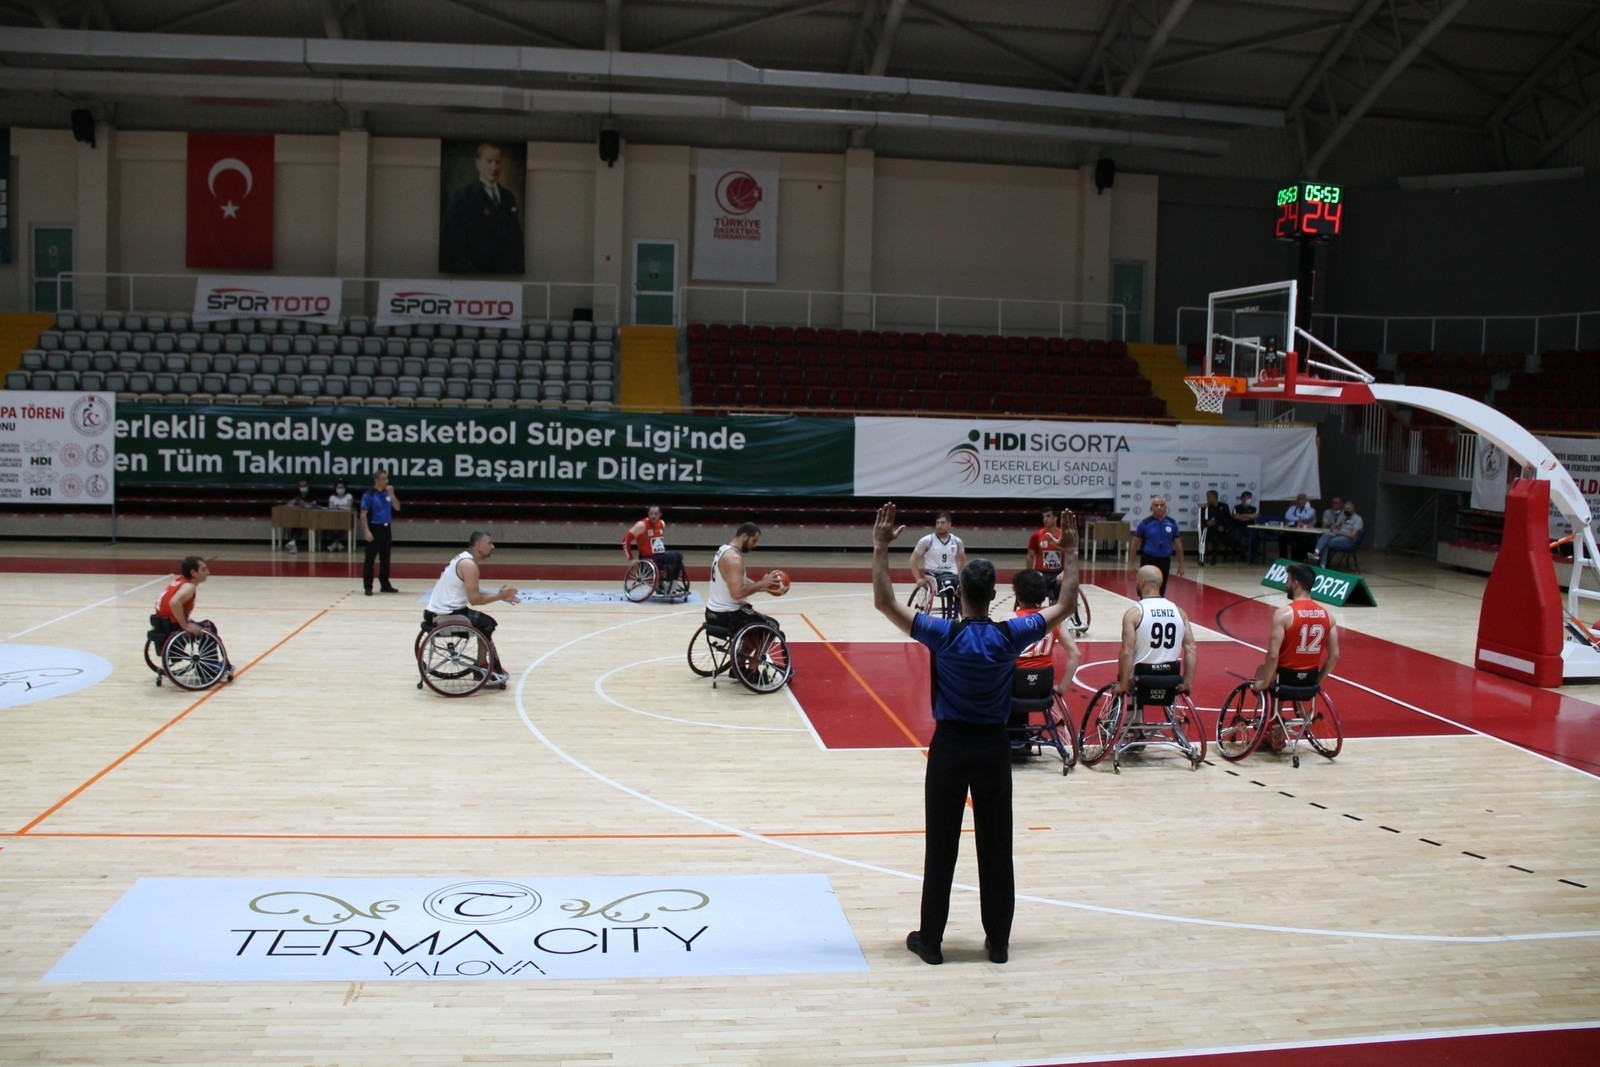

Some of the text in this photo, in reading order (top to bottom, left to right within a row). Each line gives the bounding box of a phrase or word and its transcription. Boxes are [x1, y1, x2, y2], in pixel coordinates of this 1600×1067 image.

[1277, 185, 1298, 206] 05:53
[1304, 184, 1340, 203] 05:53
[714, 216, 762, 228] TÜRKİYE
[1275, 202, 1299, 237] 24
[1302, 200, 1342, 234] 24
[216, 416, 354, 446] Sandalye
[365, 419, 516, 445] Basketbol
[527, 422, 616, 450] Süper
[983, 432, 1026, 451] HDI
[31, 457, 52, 466] HDI
[158, 449, 223, 473] Tüm
[233, 450, 443, 477] Takımlarımıza
[454, 454, 587, 482] Başarılar
[598, 457, 703, 482] Dileriz!
[983, 459, 1117, 473] TEKERLEKLİ SANDAL
[983, 474, 1060, 486] BASKETBOL
[1063, 473, 1105, 486] SÜPER
[30, 488, 51, 496] HDI
[942, 553, 947, 563] 9
[1311, 575, 1350, 600] ORTA
[1150, 622, 1177, 649] 99
[1296, 624, 1325, 654] 12
[230, 925, 709, 956] TERMA CITY
[383, 959, 546, 976] YALOVA
